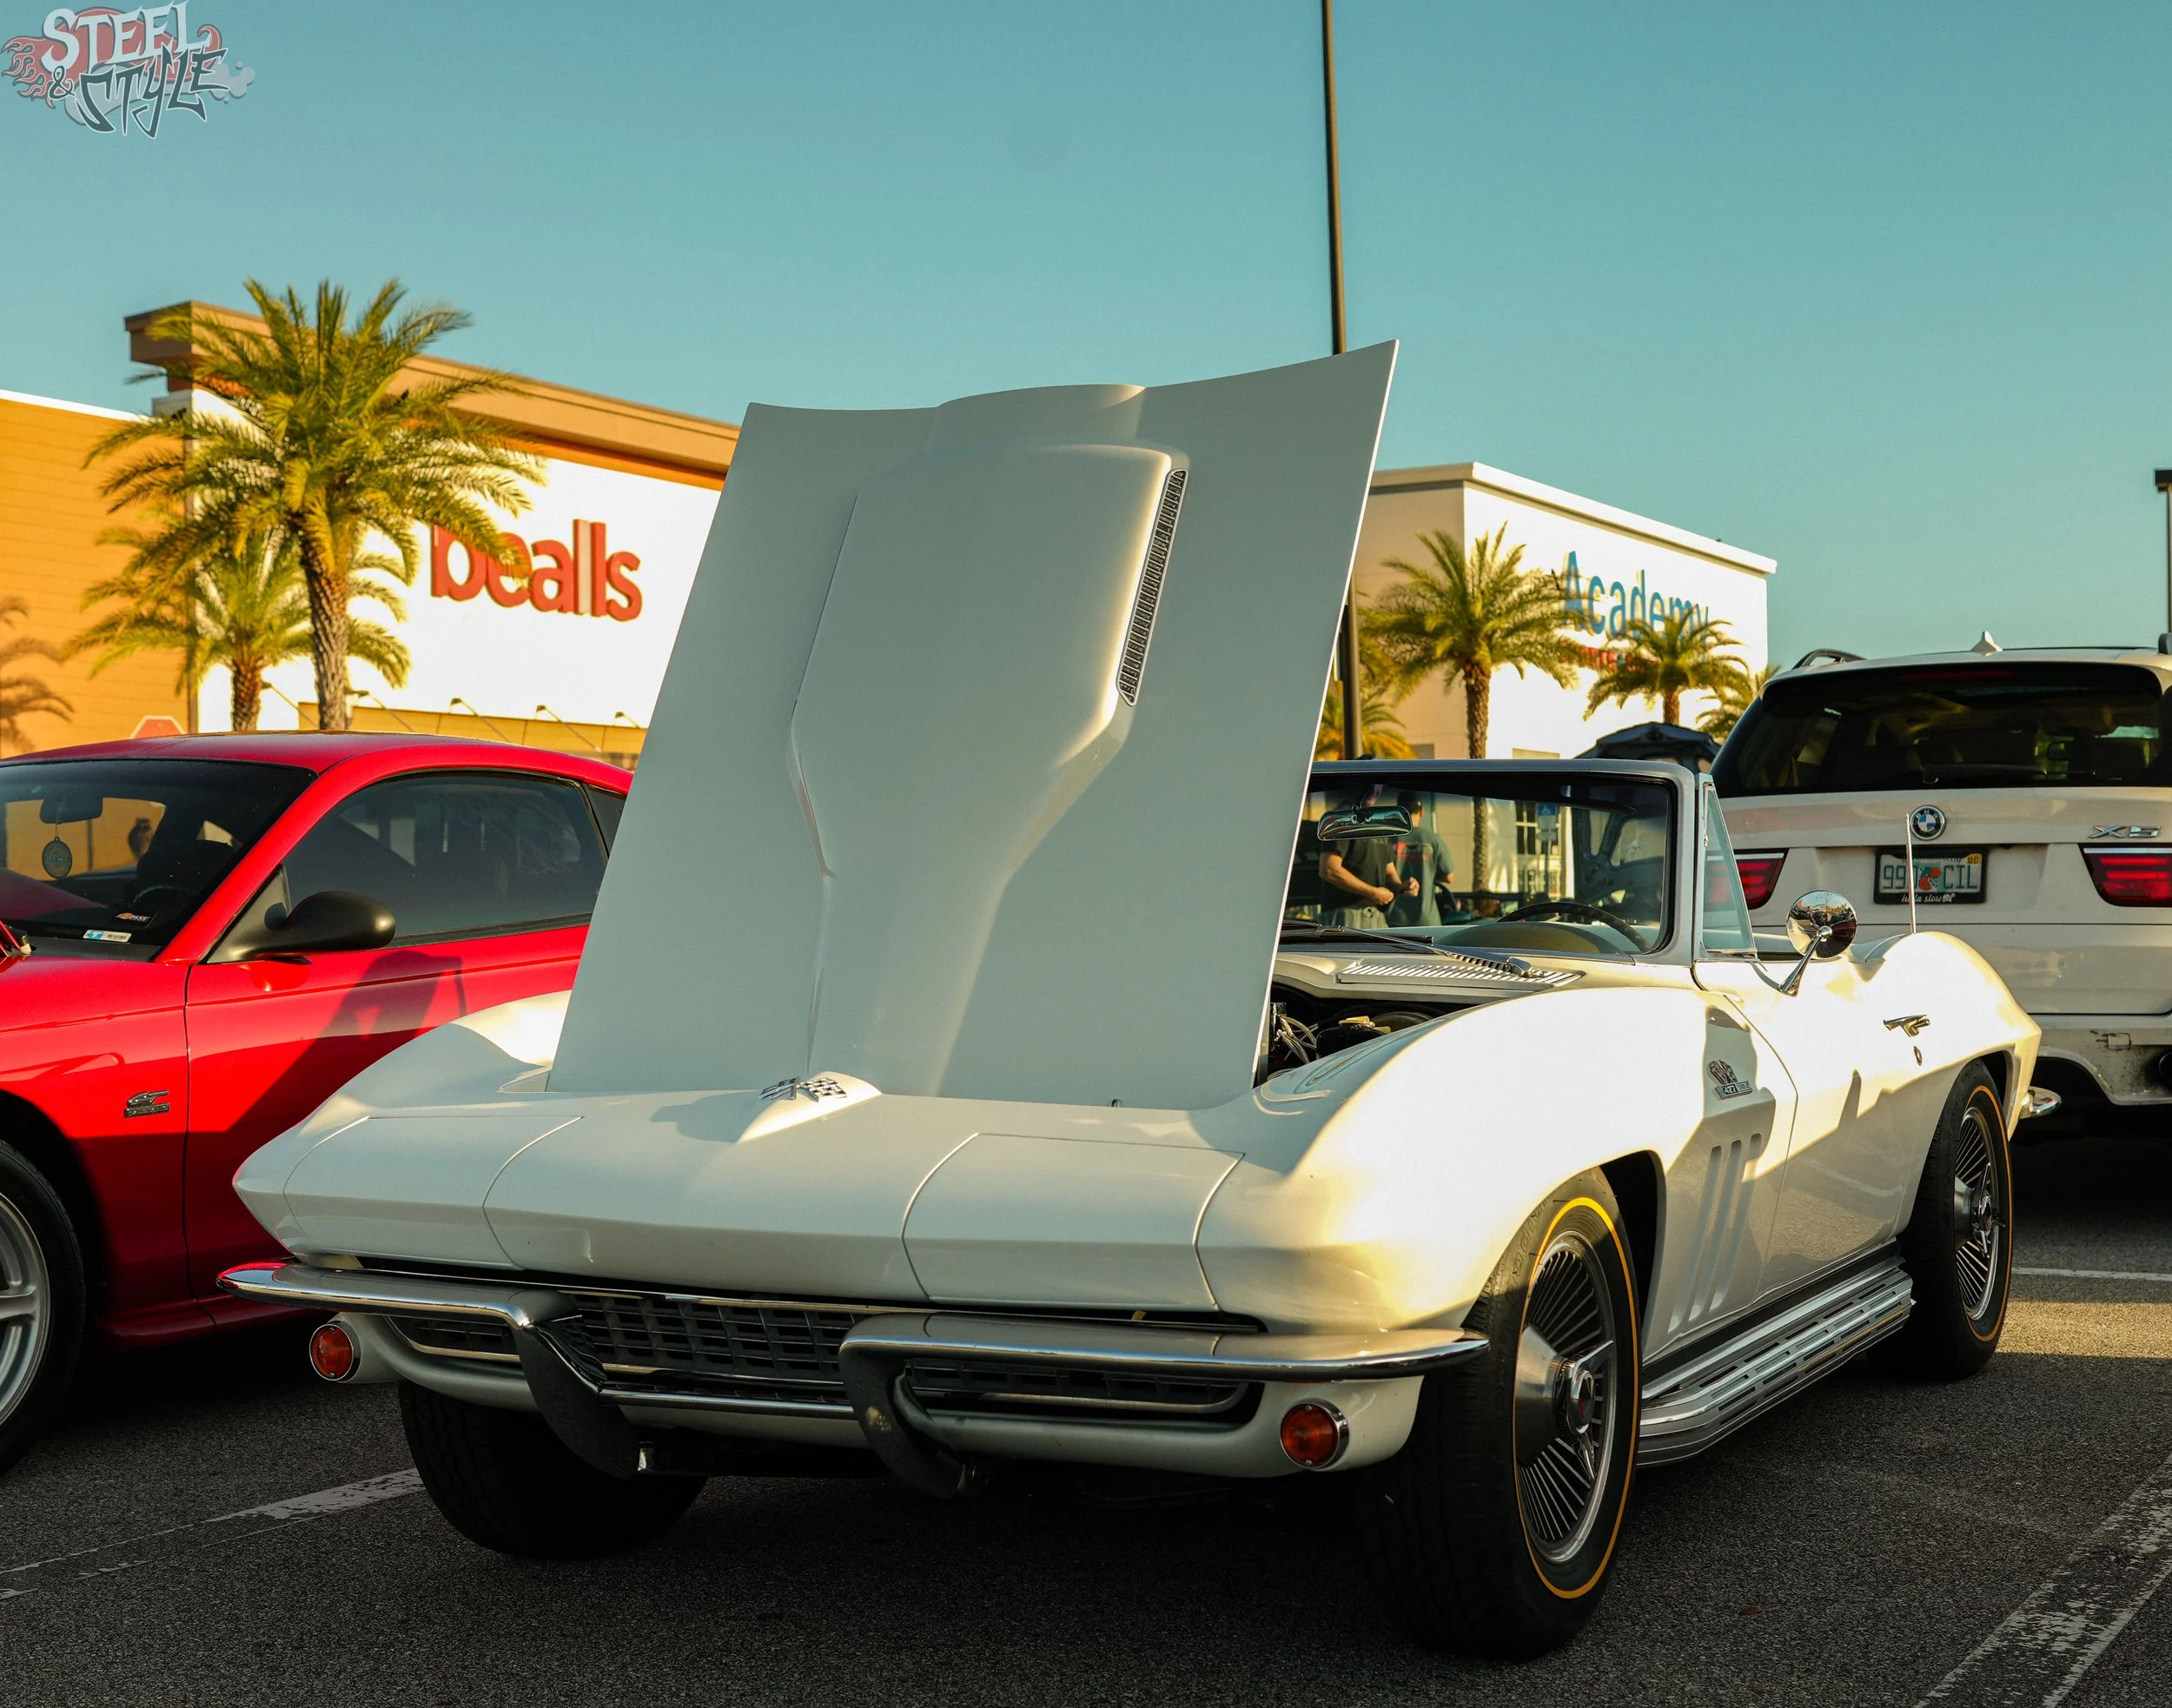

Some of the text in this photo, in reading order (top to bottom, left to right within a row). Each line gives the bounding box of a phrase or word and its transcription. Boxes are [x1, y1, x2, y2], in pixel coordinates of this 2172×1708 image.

[431, 518, 643, 622] bealls
[1562, 550, 1710, 657] Academy
[1916, 809, 1940, 819] BMW
[2089, 824, 2161, 838] X5
[1944, 864, 1978, 890] CIL
[1924, 894, 1943, 903] slow
[1724, 1085, 1736, 1094] 427
